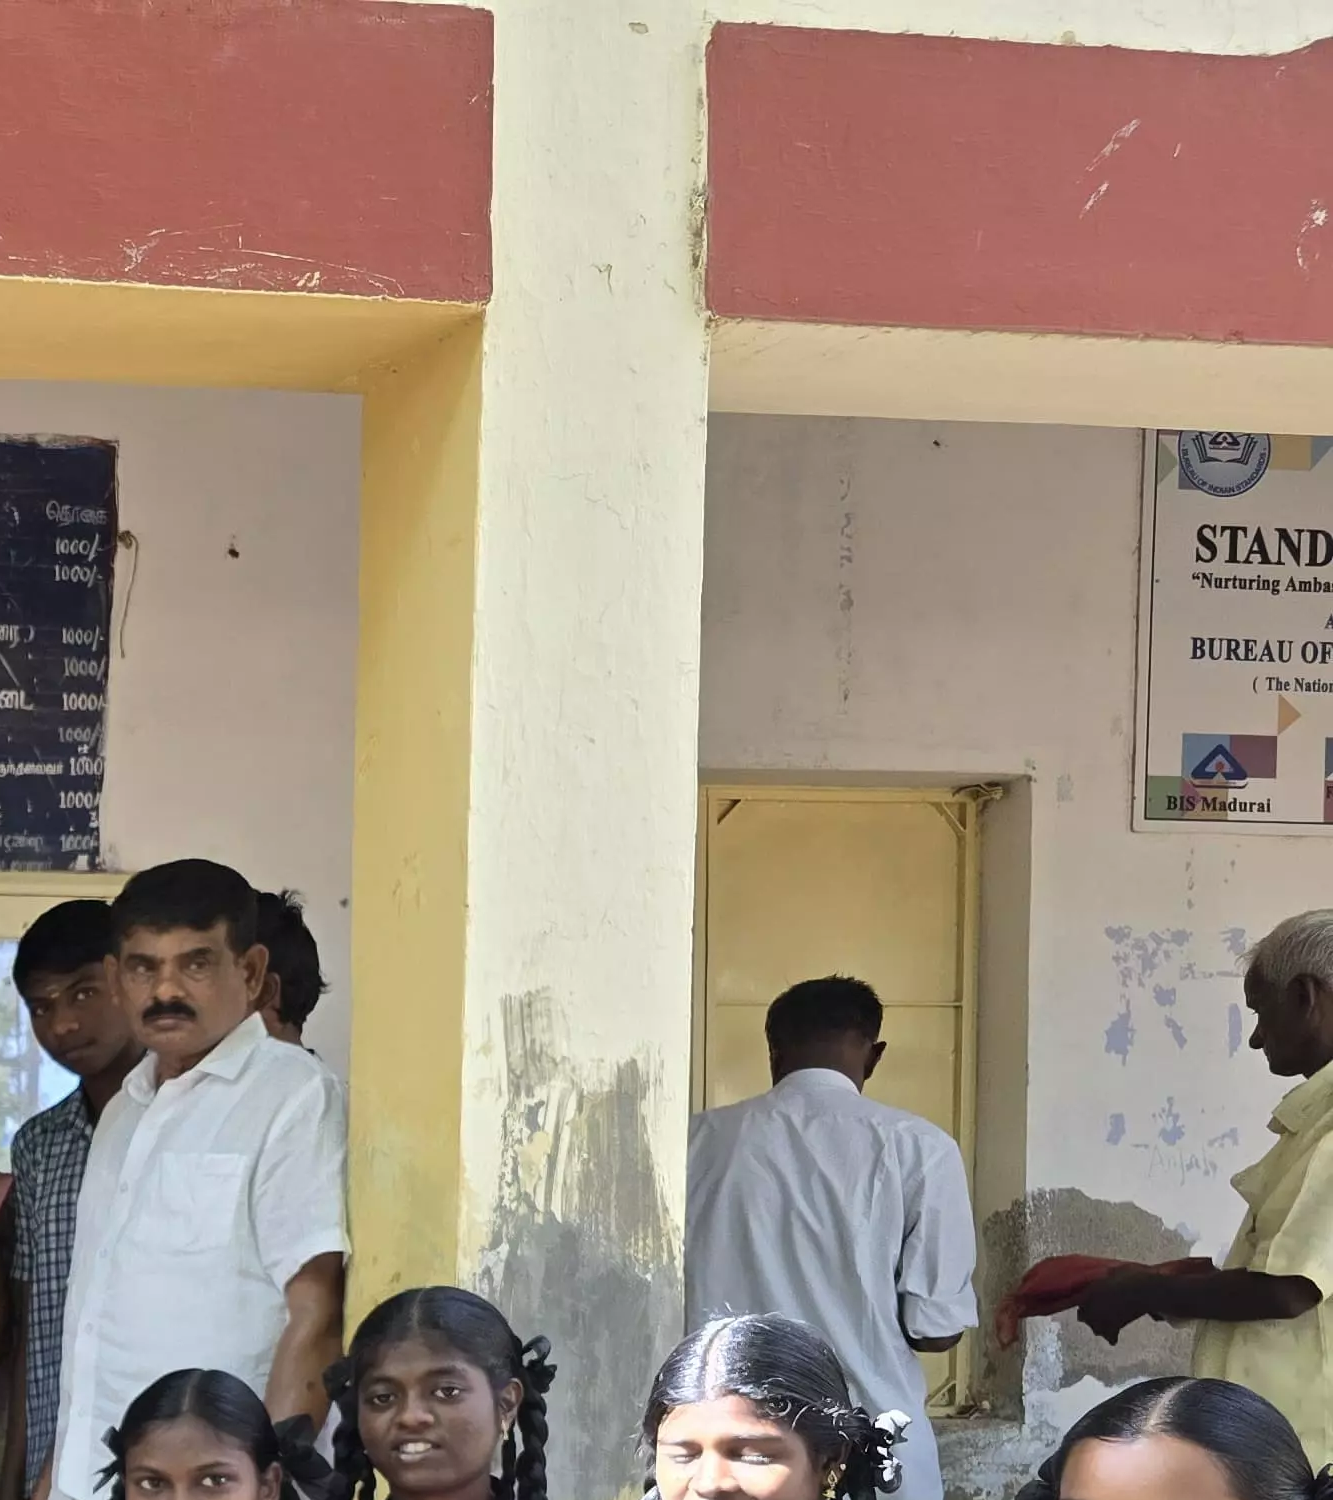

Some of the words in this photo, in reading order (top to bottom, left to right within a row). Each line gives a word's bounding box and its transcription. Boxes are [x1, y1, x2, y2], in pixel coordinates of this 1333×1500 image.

[1195, 523, 1333, 568] STAND
[1189, 636, 1294, 664] BUREAU
[1300, 640, 1333, 665] OF
[1265, 676, 1291, 692] The
[1166, 795, 1196, 812] BIS
[1201, 797, 1271, 813] Madurai
